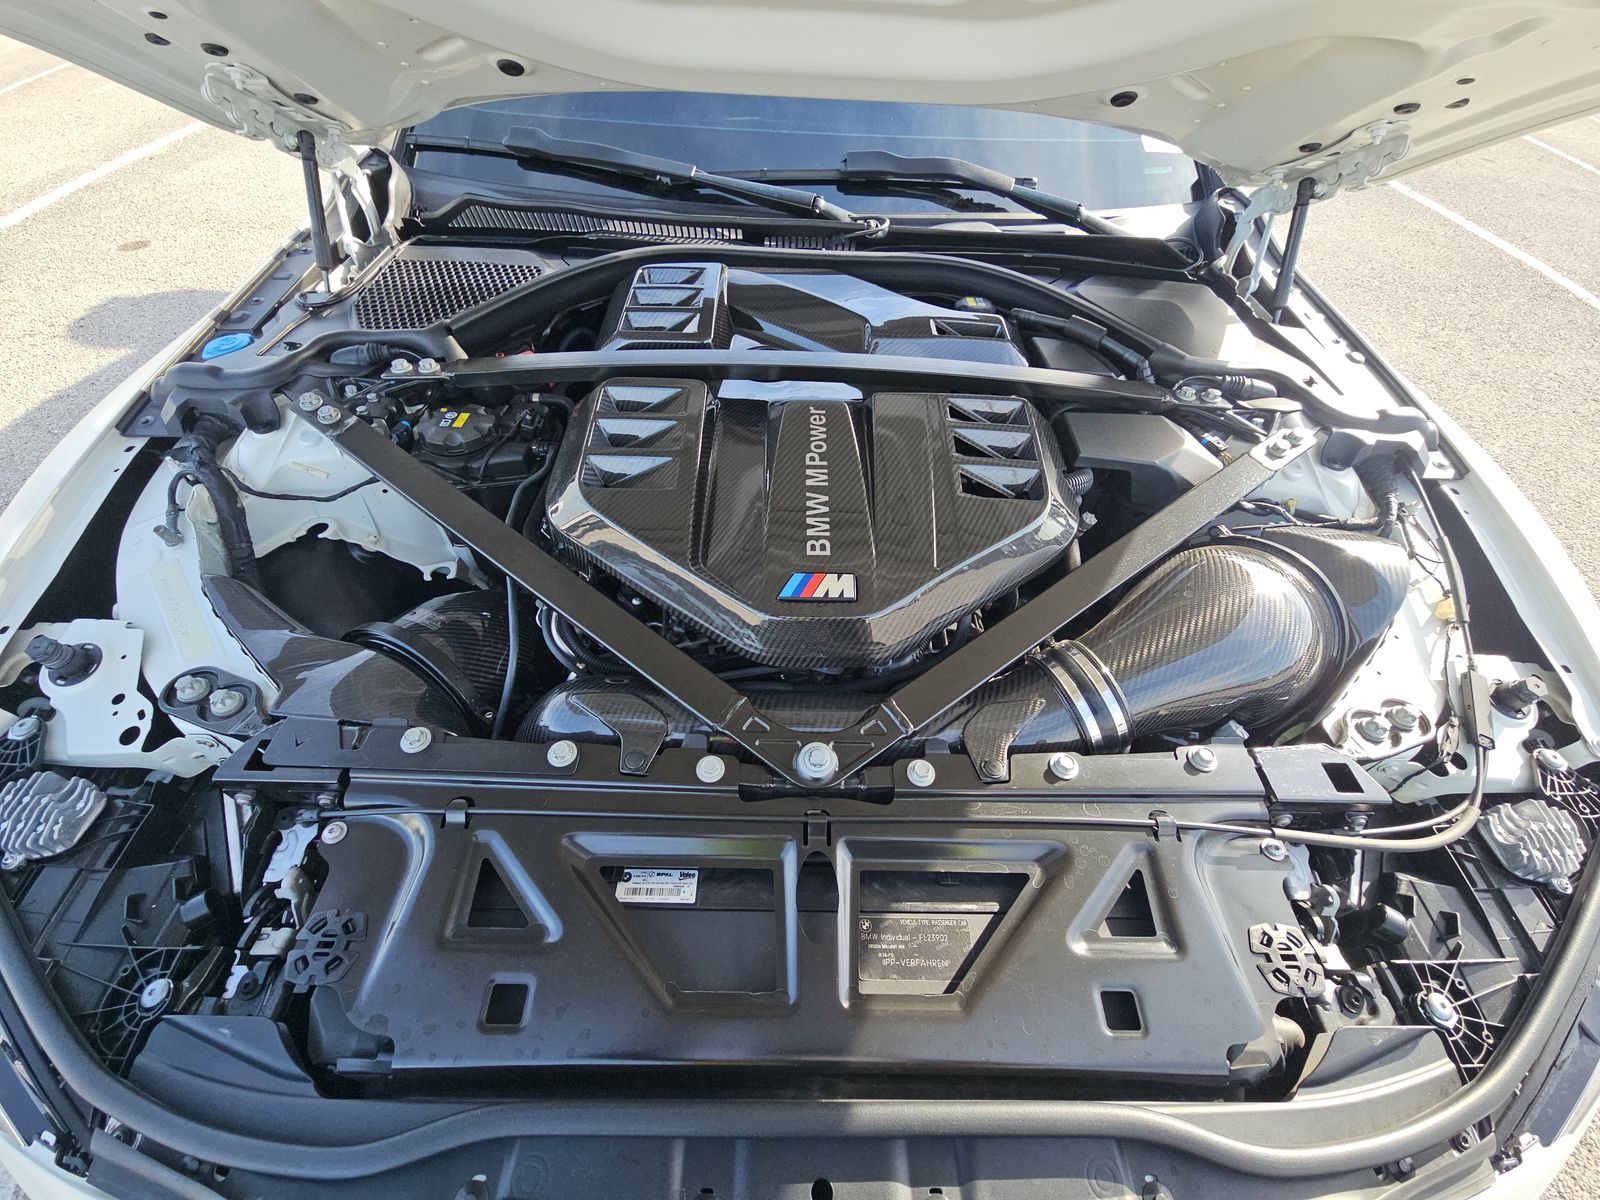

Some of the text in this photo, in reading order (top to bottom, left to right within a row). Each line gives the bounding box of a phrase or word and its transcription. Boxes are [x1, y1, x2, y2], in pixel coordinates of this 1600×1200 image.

[806, 406, 831, 556] BMW MPower
[679, 871, 696, 880] Valeo
